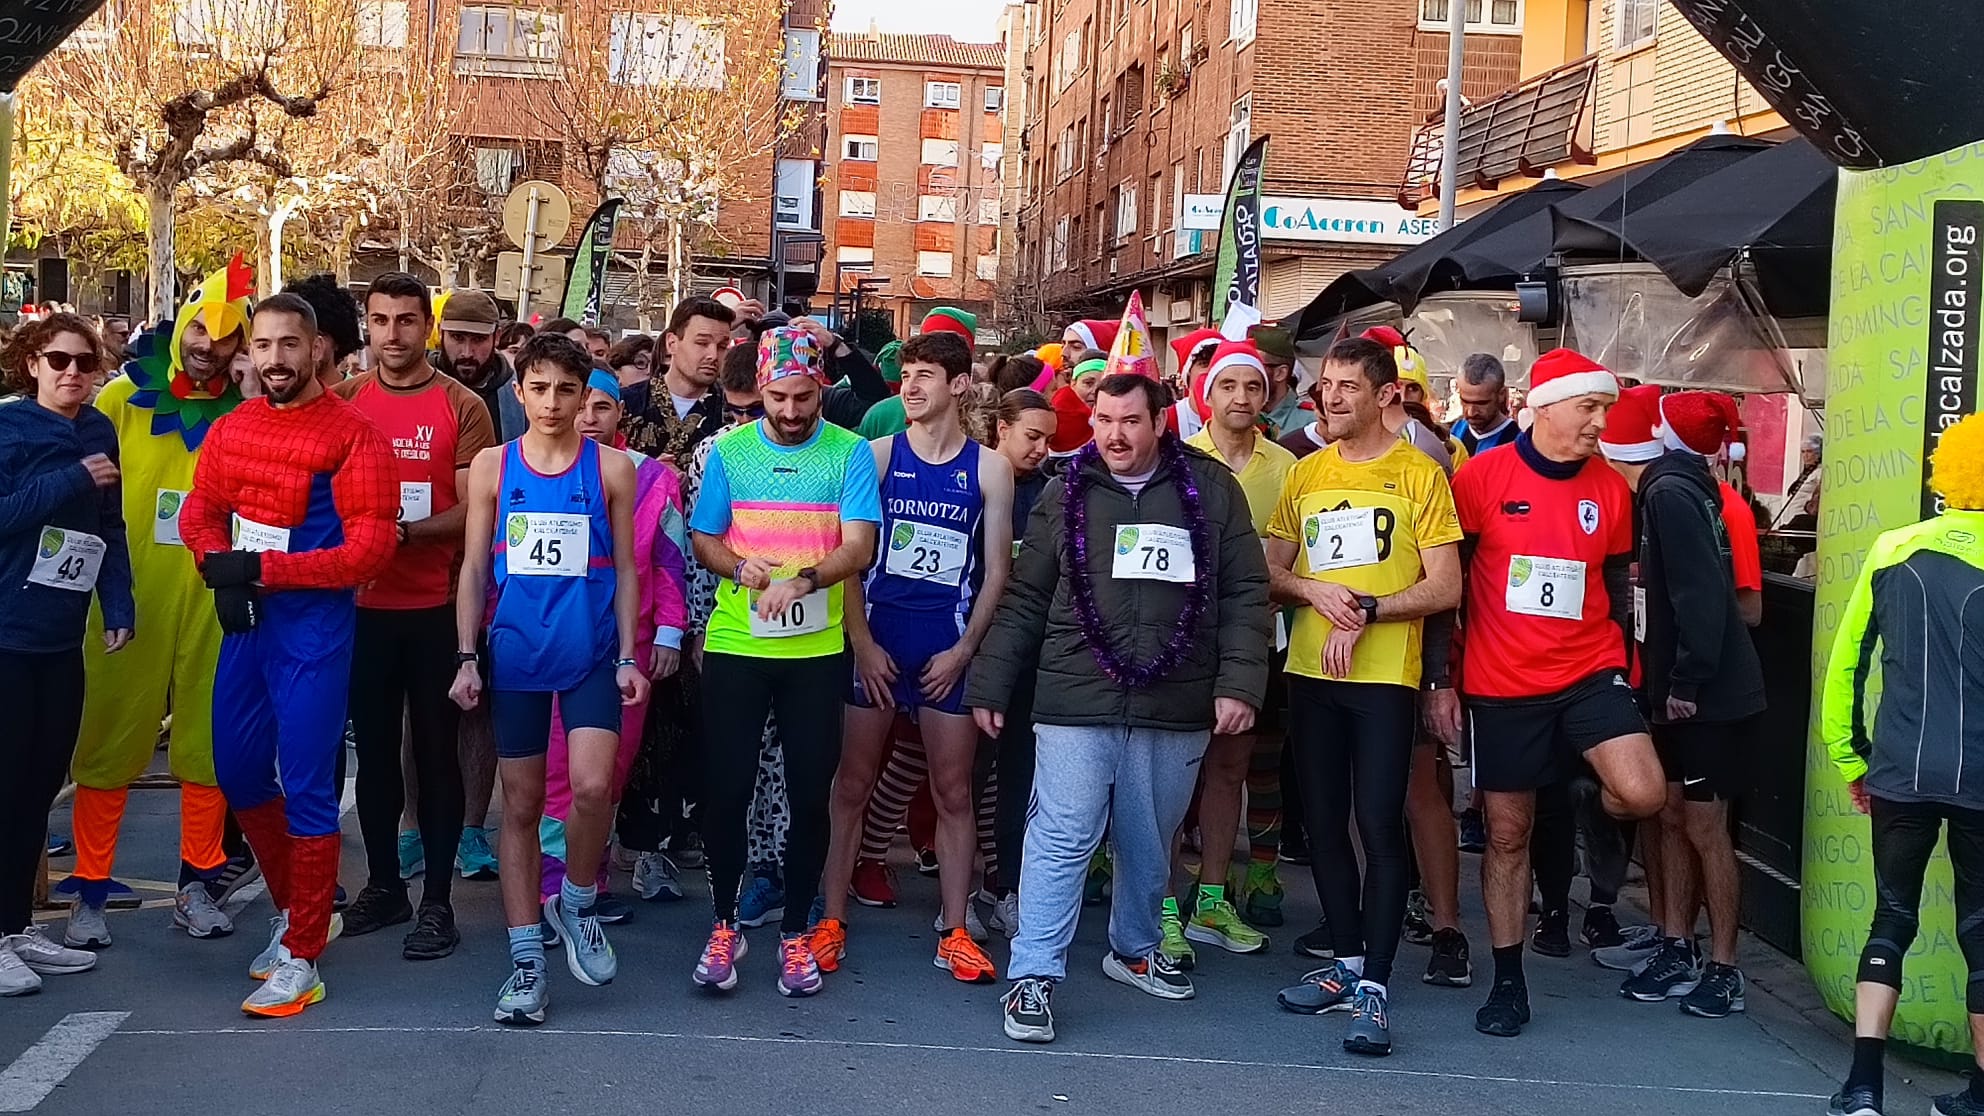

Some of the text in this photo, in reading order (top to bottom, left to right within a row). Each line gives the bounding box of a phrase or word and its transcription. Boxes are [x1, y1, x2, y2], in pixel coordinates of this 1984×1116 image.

[1860, 399, 1892, 433] LA
[416, 424, 434, 441] XV
[529, 538, 562, 566] 45
[910, 546, 941, 573] 23
[1141, 546, 1169, 572] 78
[1329, 534, 1344, 560] 2
[58, 555, 85, 581] 43
[1540, 582, 1554, 607] 8
[780, 601, 805, 628] 10
